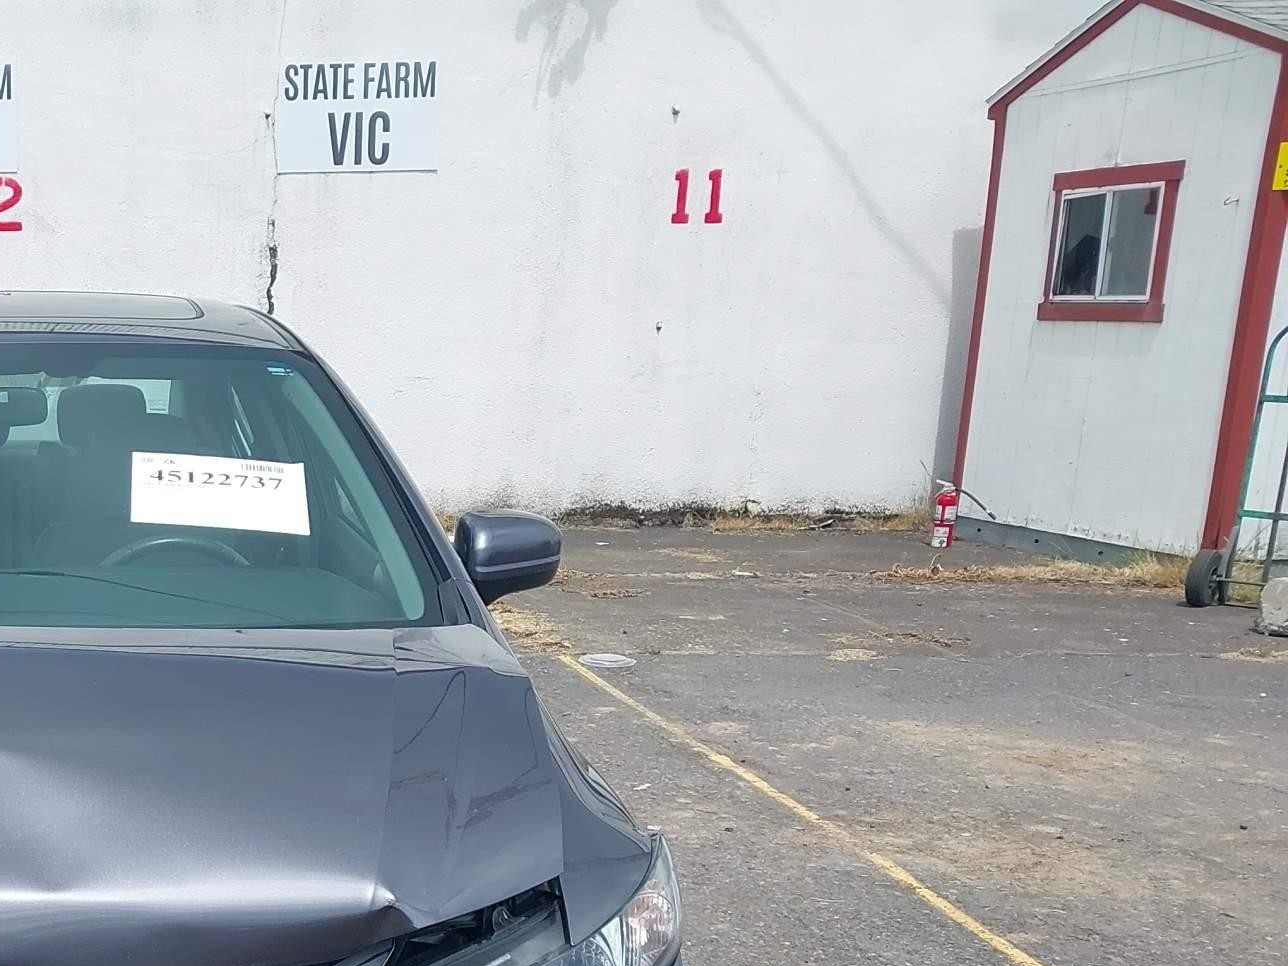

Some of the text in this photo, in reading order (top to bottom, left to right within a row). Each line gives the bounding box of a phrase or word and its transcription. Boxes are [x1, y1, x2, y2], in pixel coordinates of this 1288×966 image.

[284, 61, 436, 101] STATE FARM
[327, 110, 391, 166] VIC
[670, 169, 723, 225] 11
[149, 468, 283, 490] 45122737
